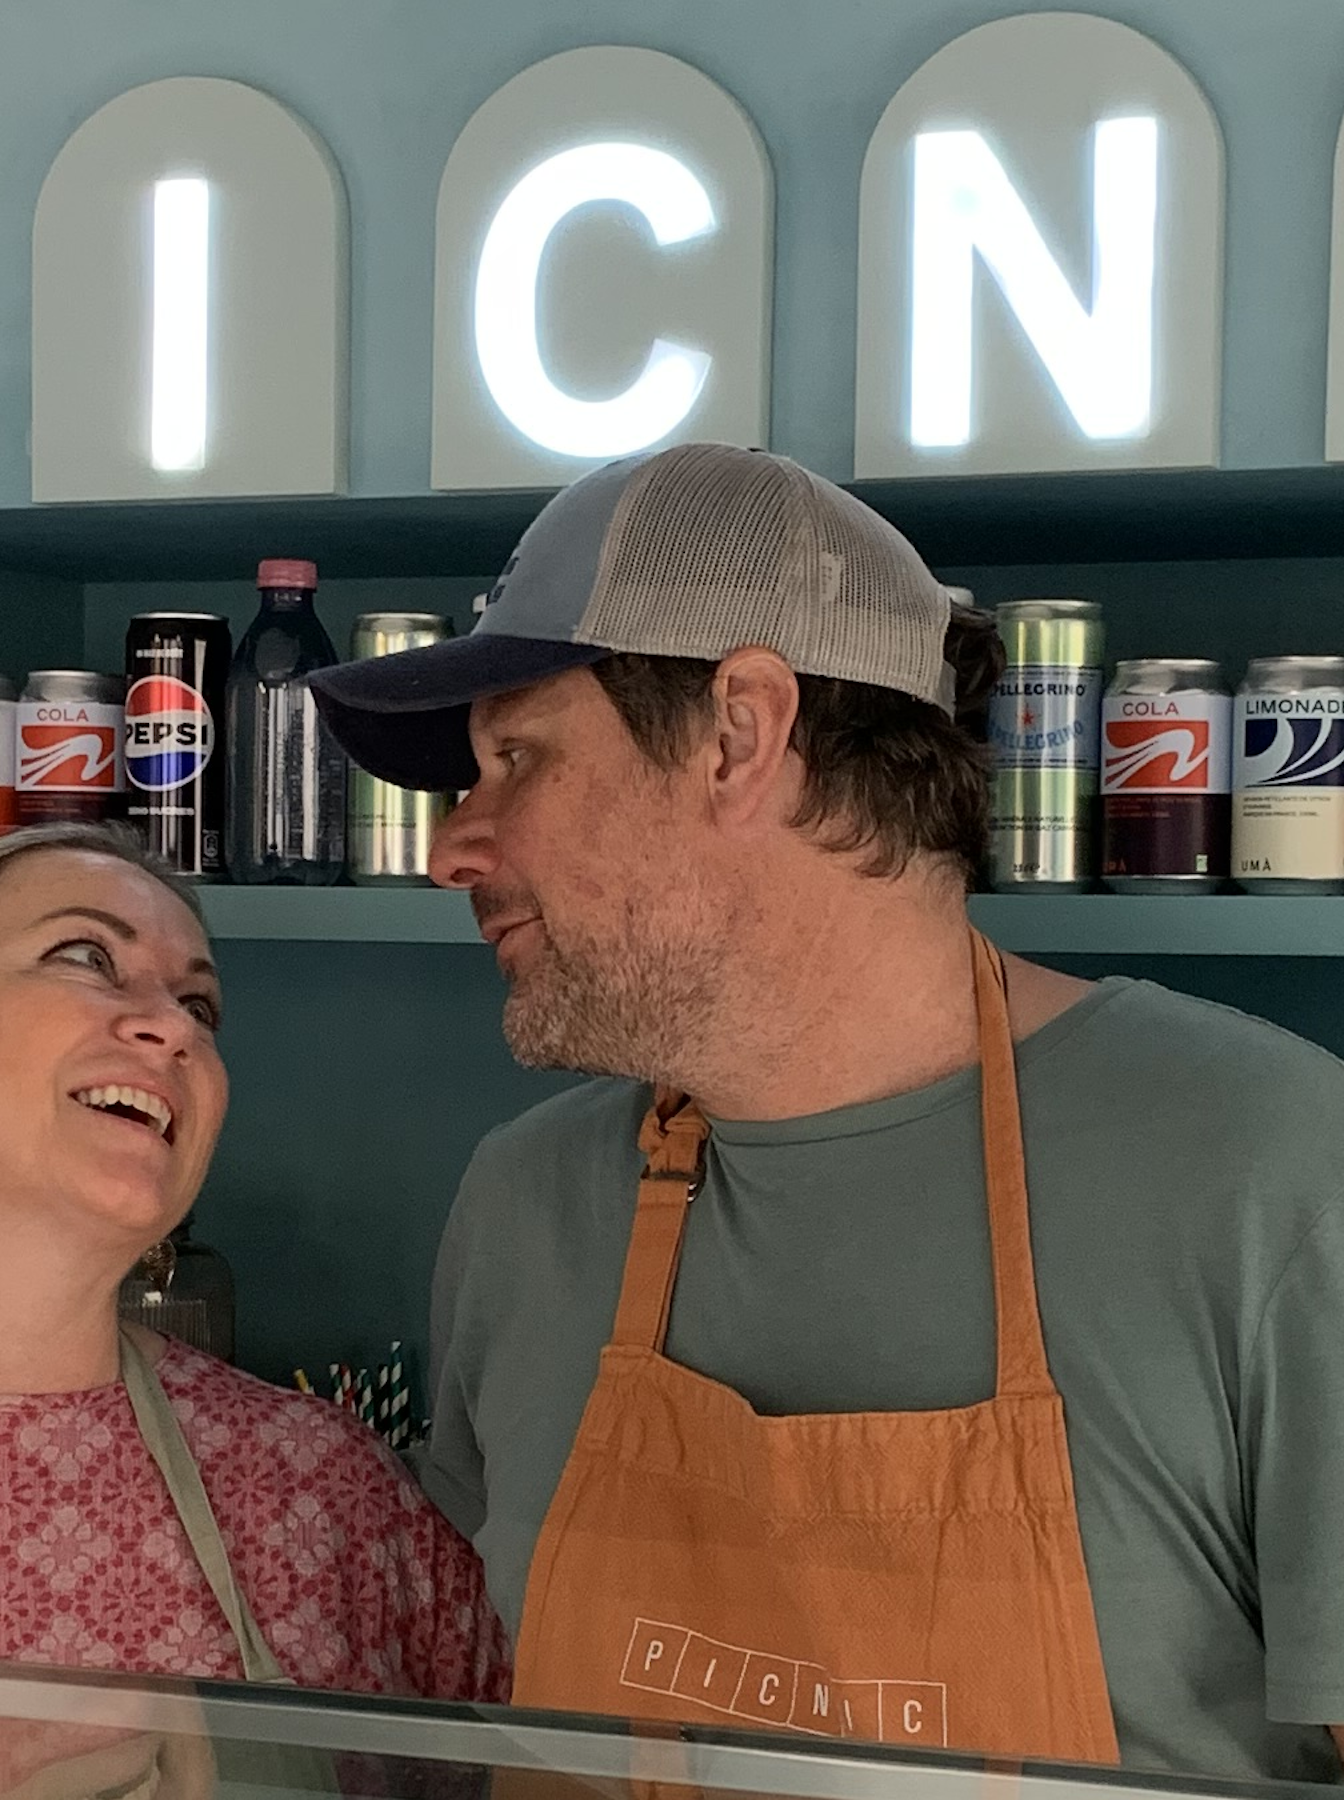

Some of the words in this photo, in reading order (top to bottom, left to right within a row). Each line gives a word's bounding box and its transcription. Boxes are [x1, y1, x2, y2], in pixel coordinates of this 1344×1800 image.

[37, 709, 89, 721] COLA
[1122, 702, 1179, 717] COLA
[644, 1640, 923, 1733] PICNIC
